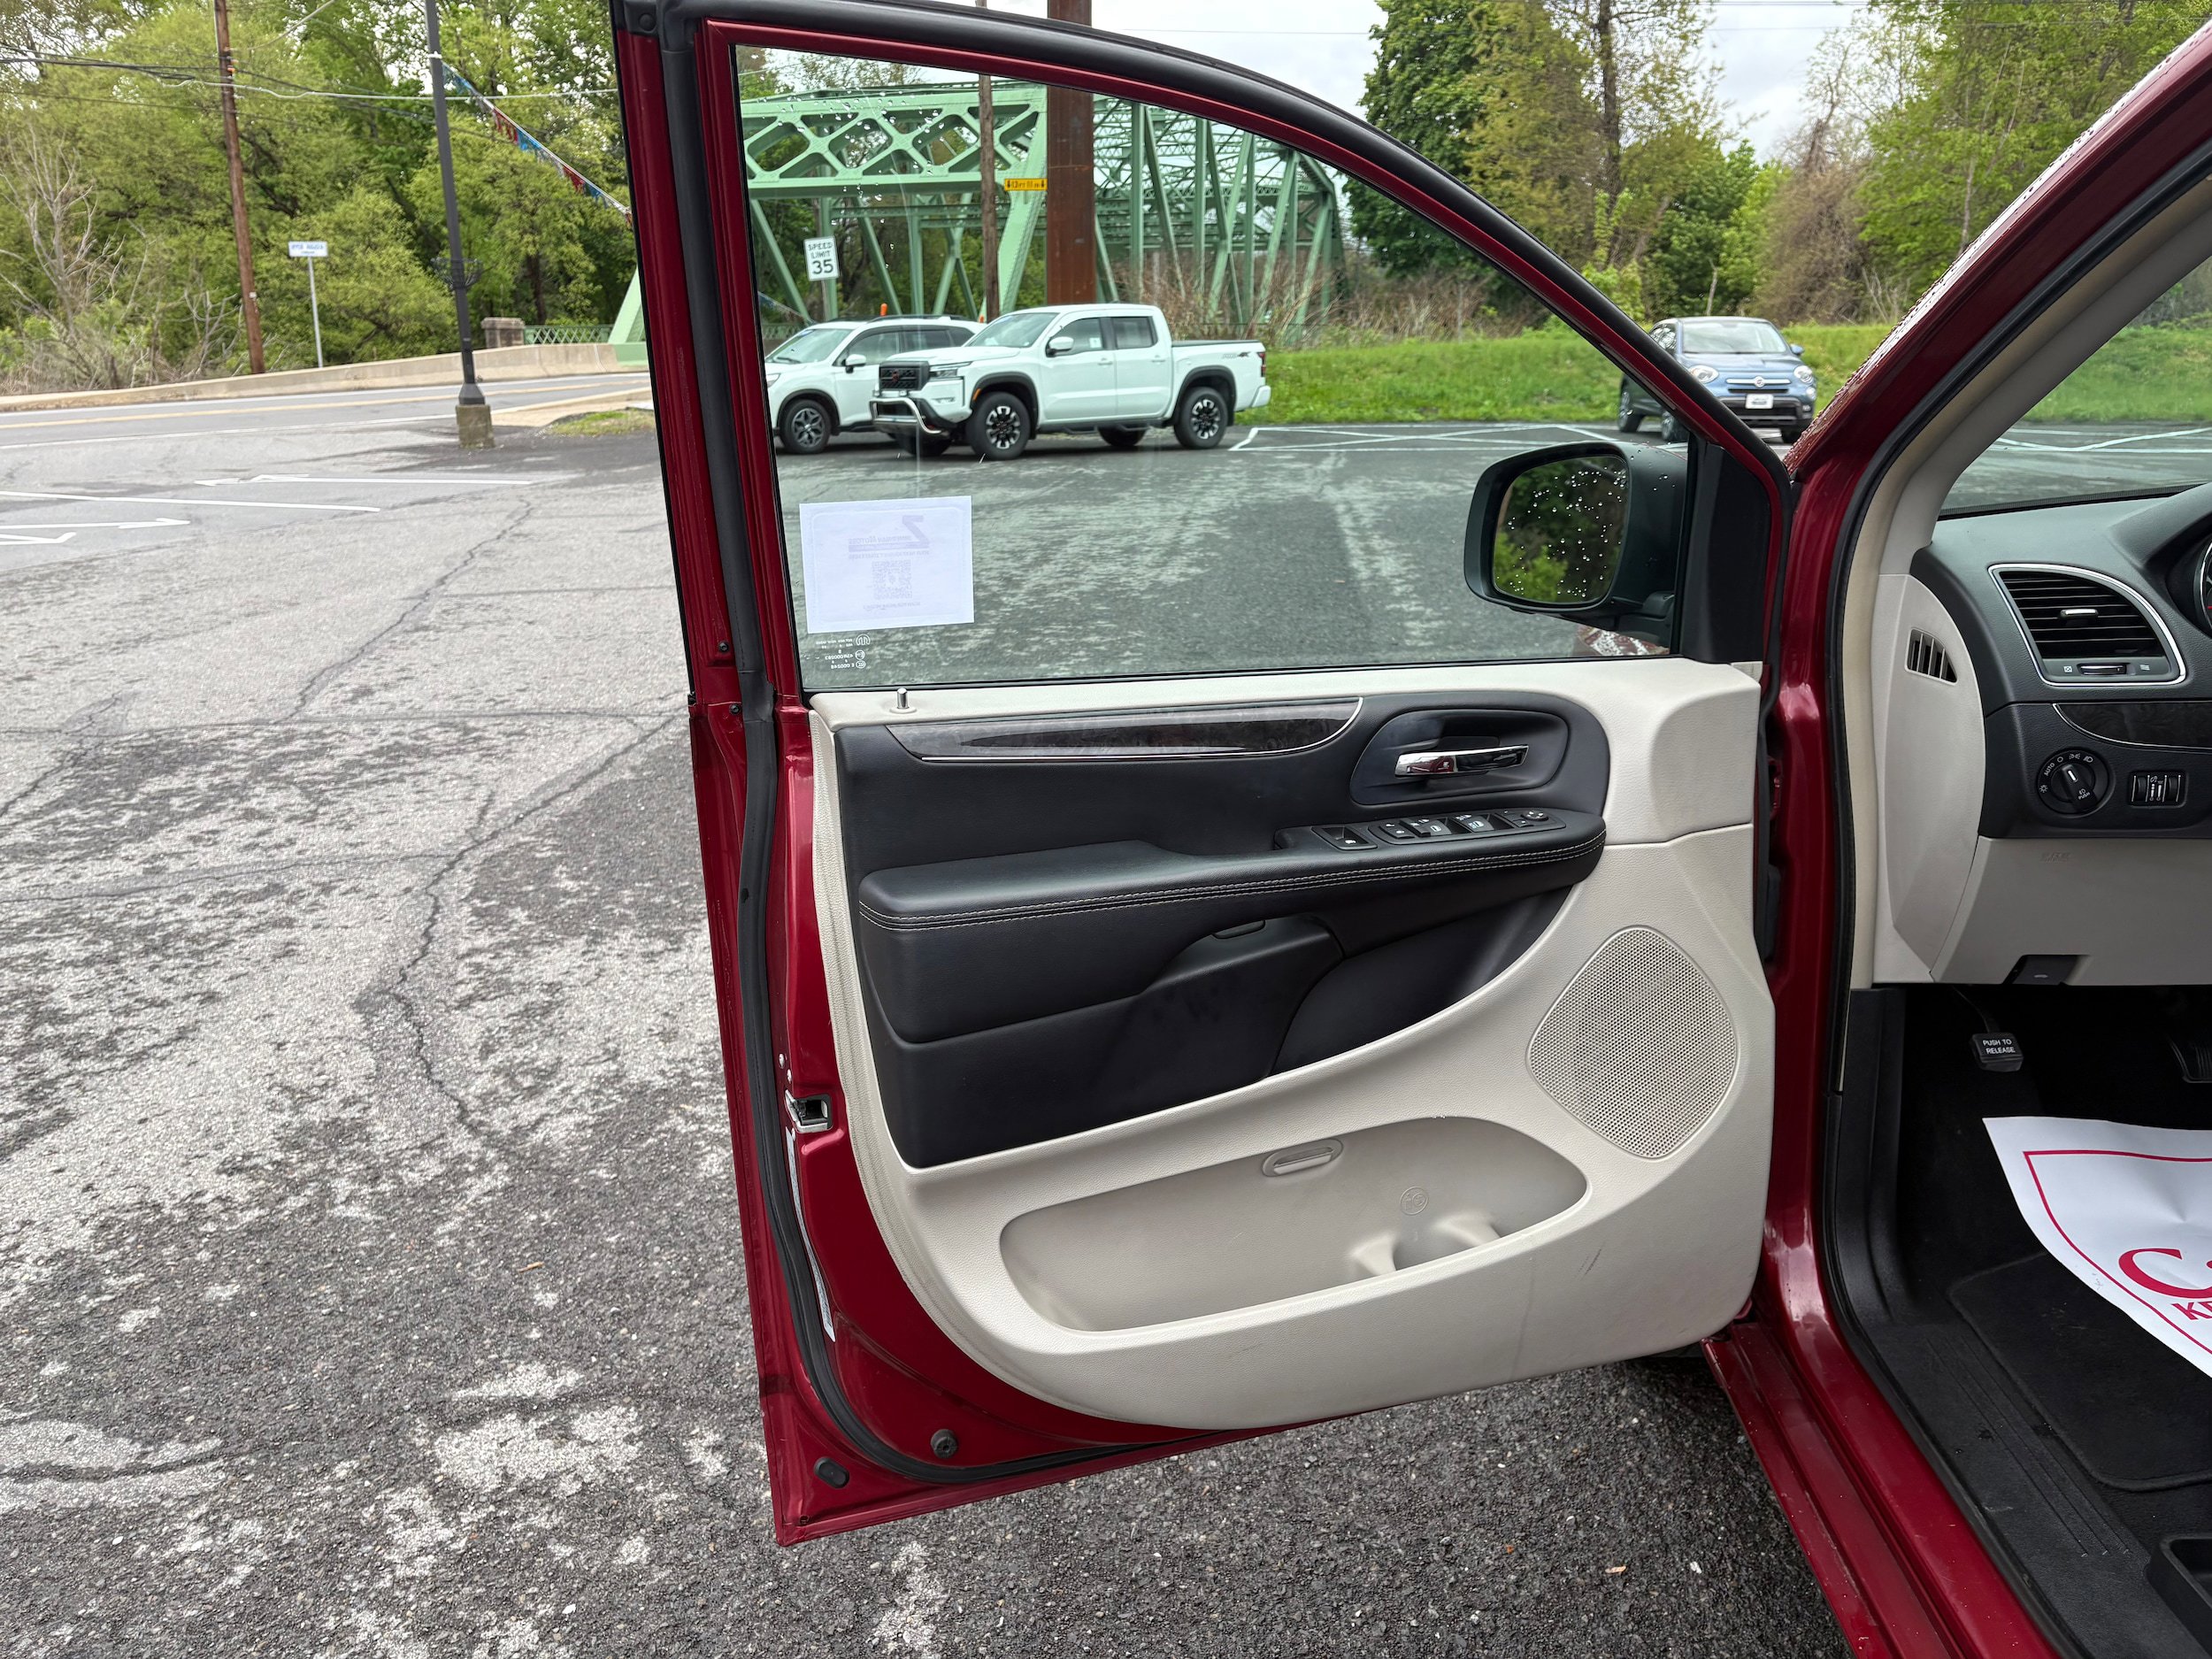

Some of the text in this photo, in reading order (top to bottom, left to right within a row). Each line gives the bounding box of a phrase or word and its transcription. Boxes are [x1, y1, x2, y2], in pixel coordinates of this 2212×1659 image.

[808, 242, 833, 251] SPEED
[810, 250, 831, 259] LIMIT
[812, 258, 833, 274] 35
[2044, 763, 2055, 776] AUTO
[2078, 791, 2090, 800] PUSH
[1985, 1046, 2016, 1055] RELEASE
